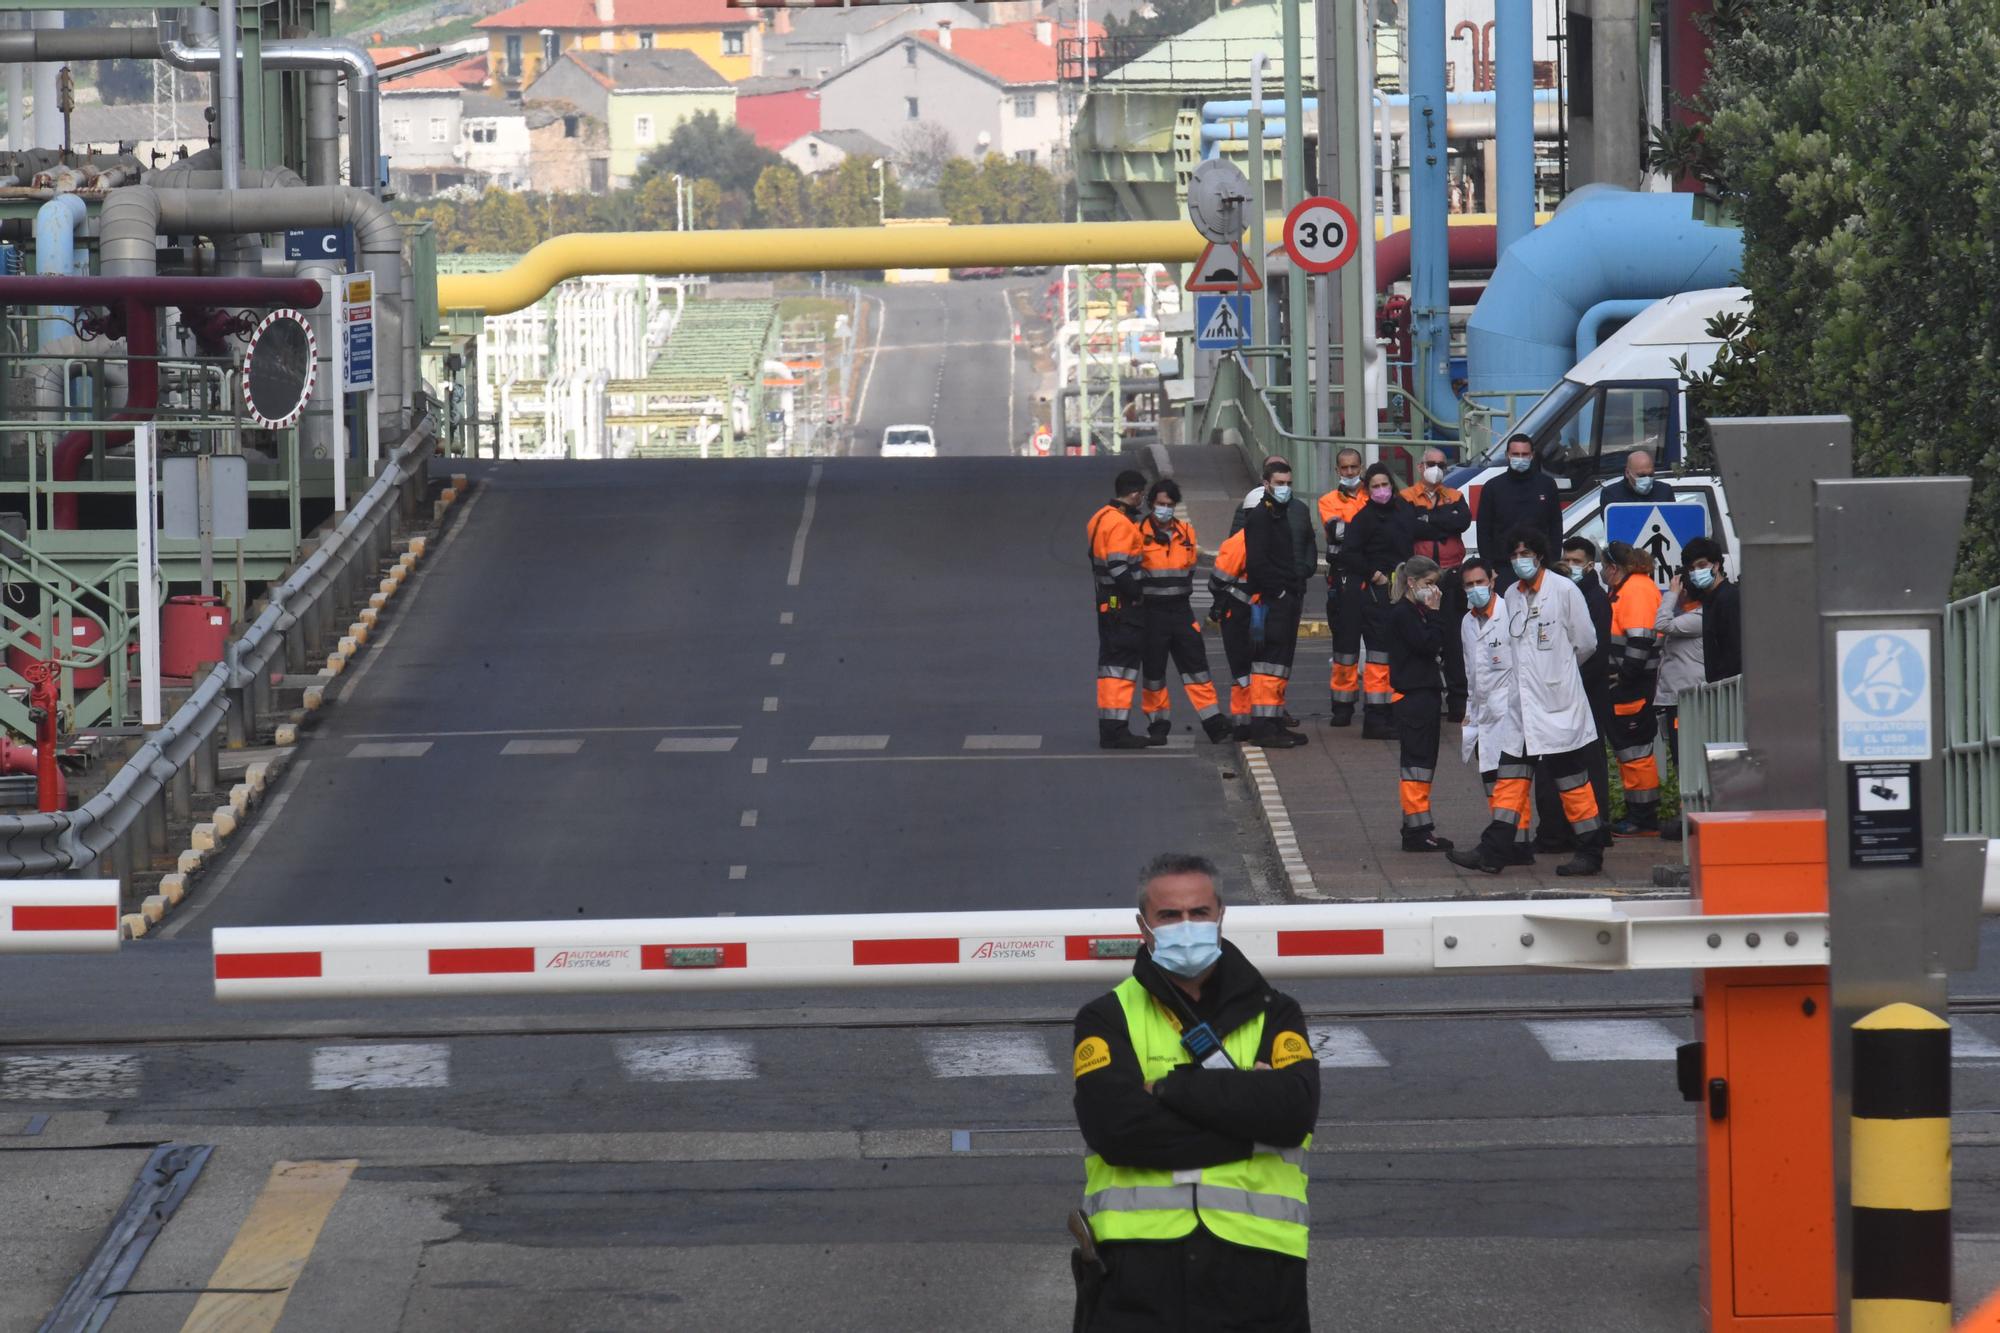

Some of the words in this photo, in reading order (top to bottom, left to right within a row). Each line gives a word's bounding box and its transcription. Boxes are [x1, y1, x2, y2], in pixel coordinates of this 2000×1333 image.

[1299, 222, 1344, 248] 30
[321, 234, 337, 253] C
[994, 940, 1055, 950] AUTOMATIC
[568, 950, 629, 959] AUTOMATIC
[992, 950, 1036, 958] SYSTEMS
[567, 959, 611, 968] SYSTEMS
